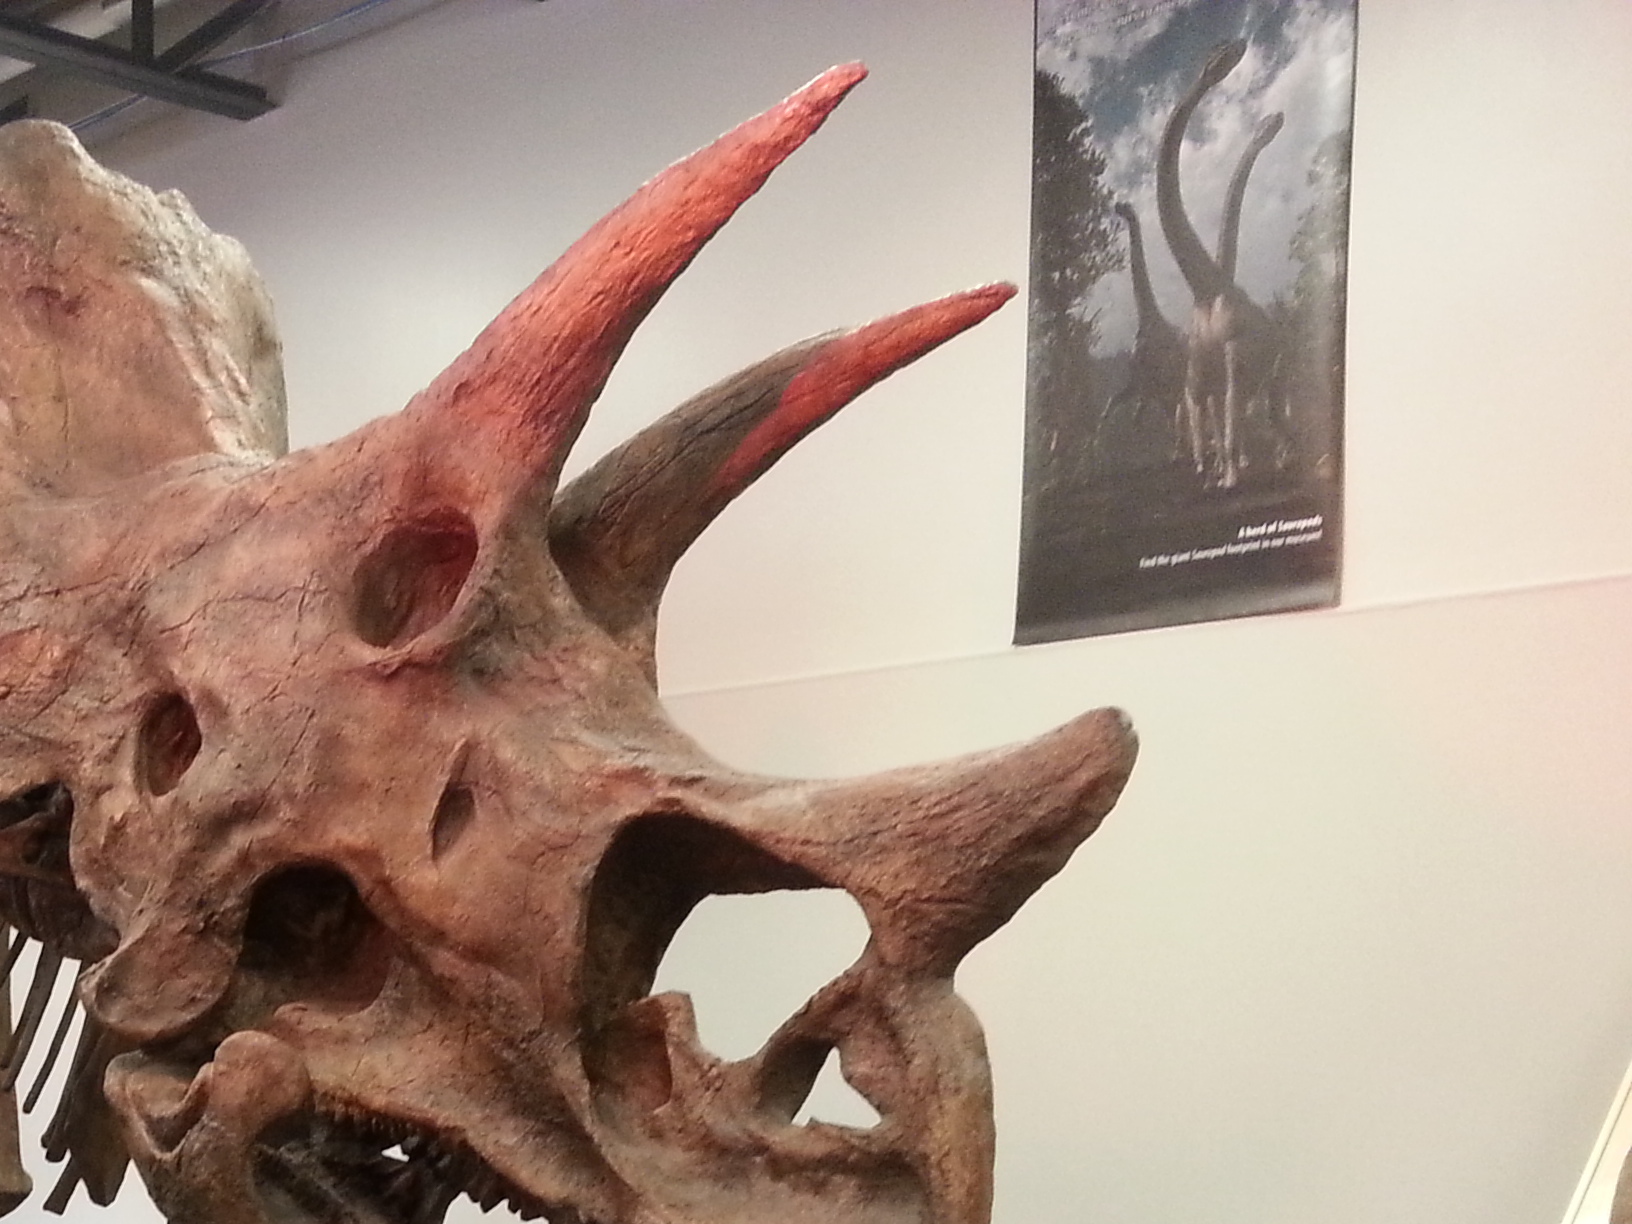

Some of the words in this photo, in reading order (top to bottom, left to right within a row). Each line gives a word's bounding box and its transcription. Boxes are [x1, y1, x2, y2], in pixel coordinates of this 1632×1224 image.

[1237, 526, 1245, 539] A
[1245, 522, 1266, 538] herd
[1266, 520, 1278, 535] of
[1157, 554, 1170, 566] the
